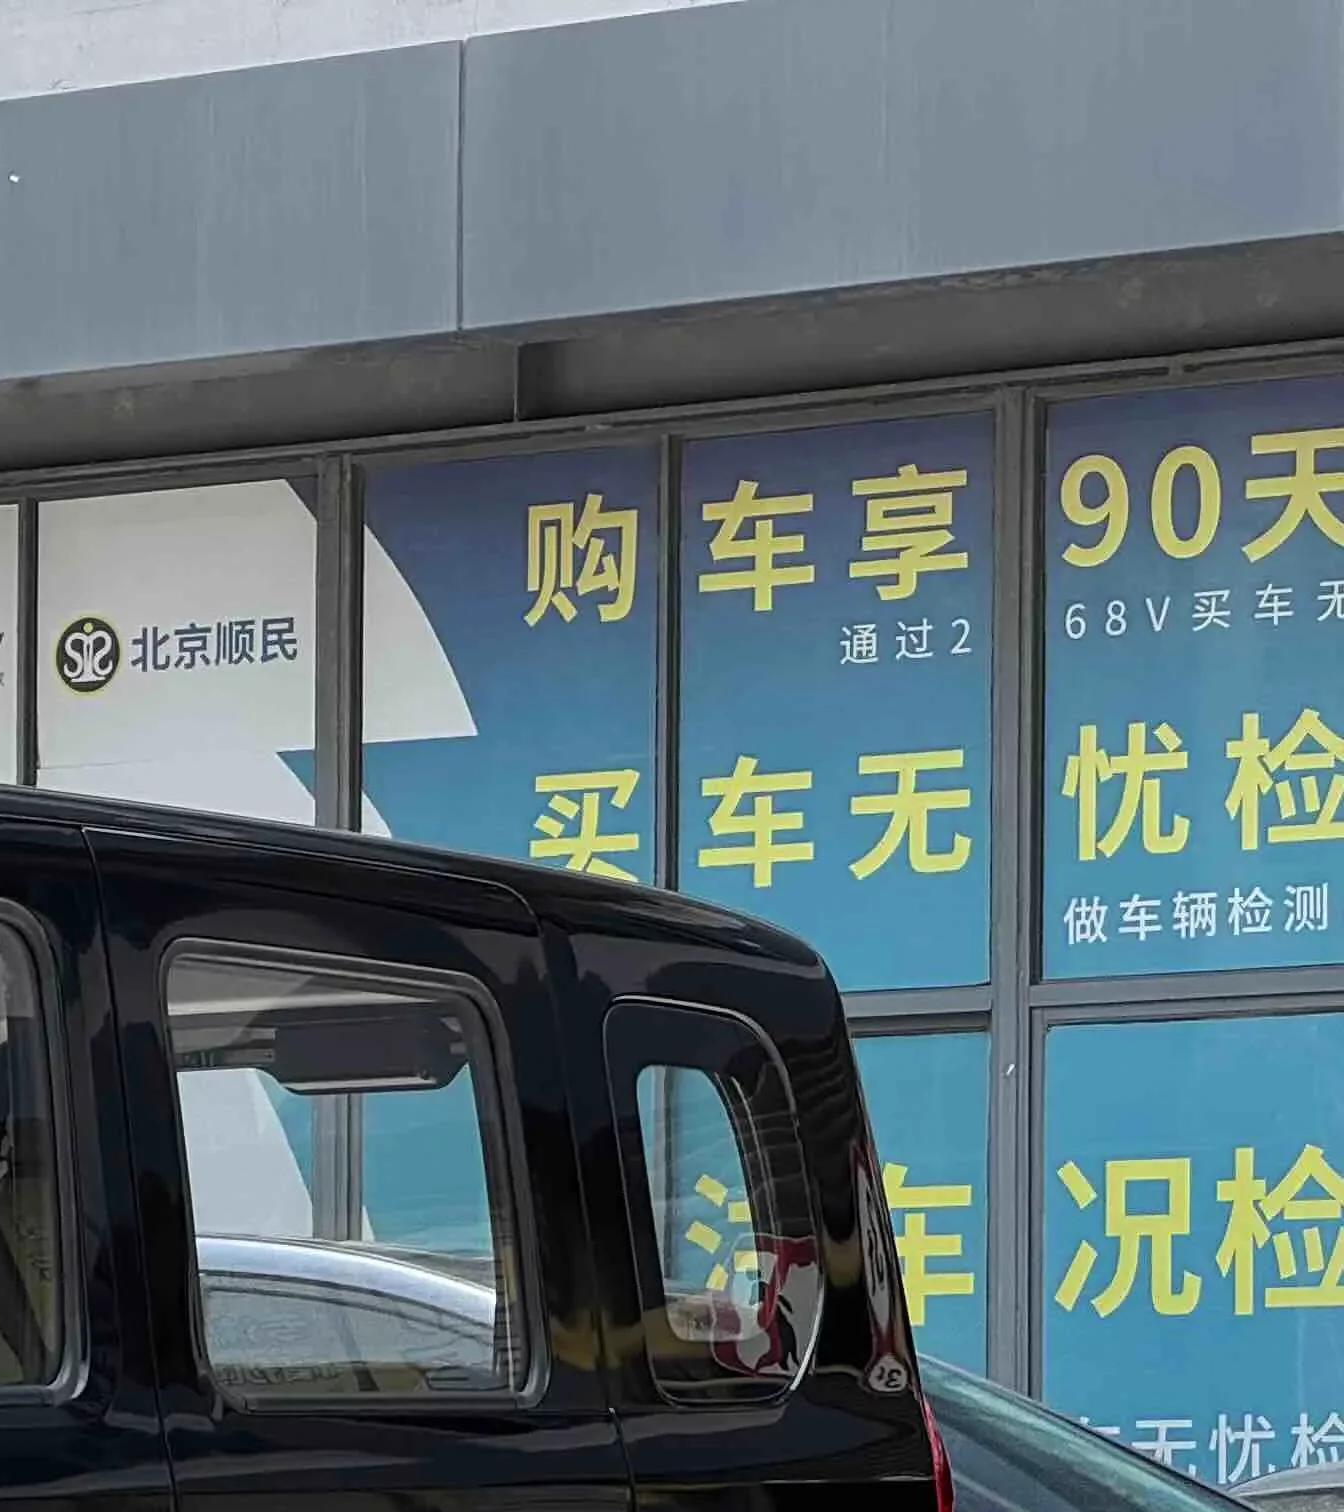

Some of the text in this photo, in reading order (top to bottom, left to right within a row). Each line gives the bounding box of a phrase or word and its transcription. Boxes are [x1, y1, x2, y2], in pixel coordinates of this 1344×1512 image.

[129, 615, 299, 674] 北京顺民
[1062, 882, 1329, 945] 做车辆检测
